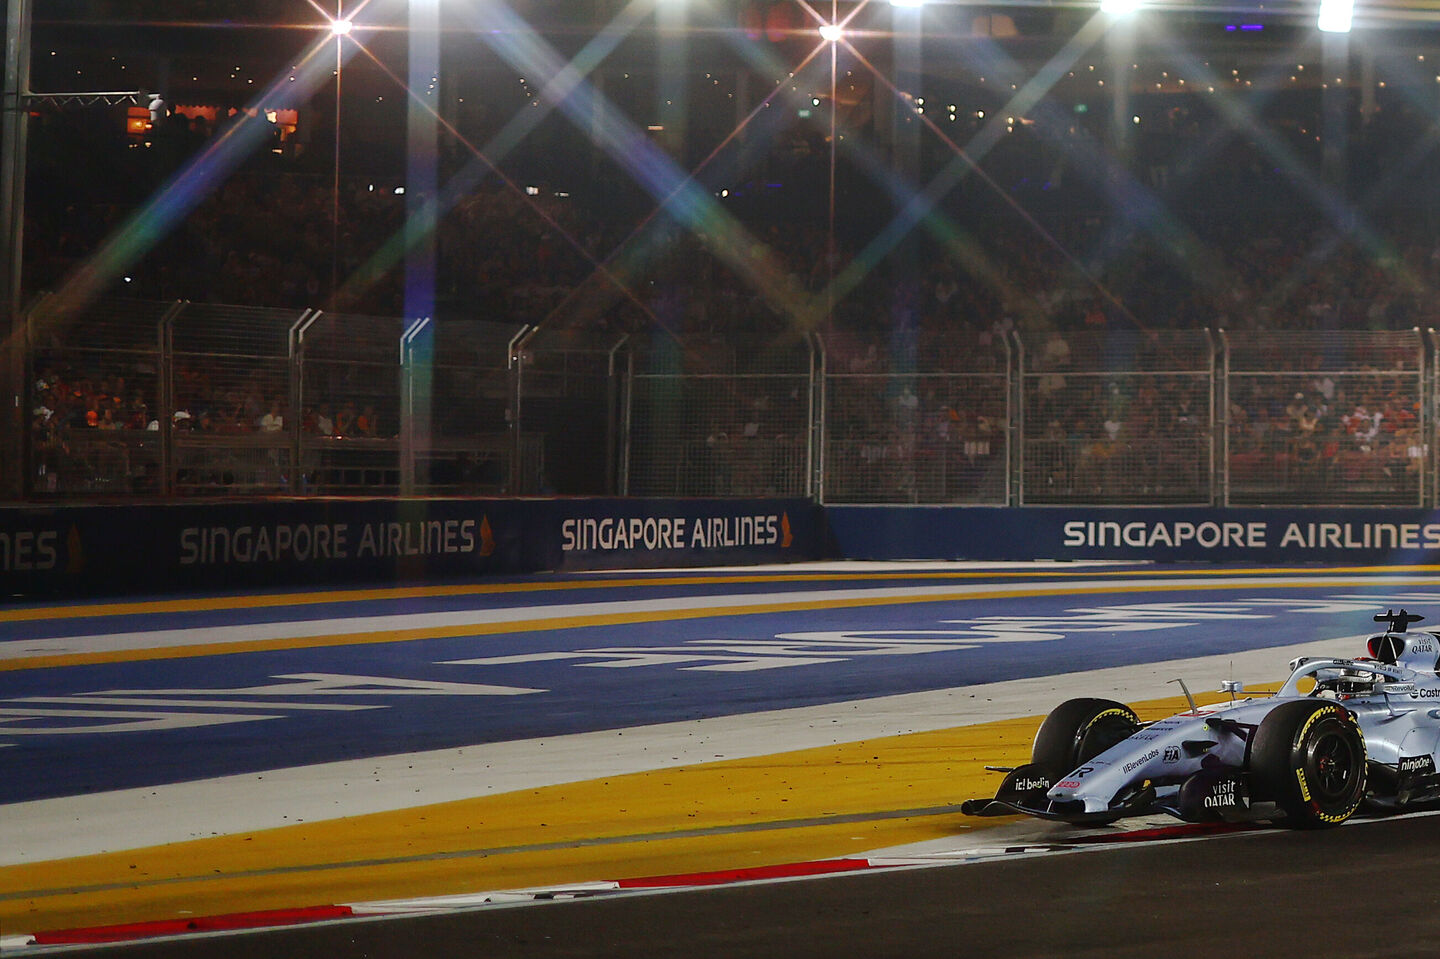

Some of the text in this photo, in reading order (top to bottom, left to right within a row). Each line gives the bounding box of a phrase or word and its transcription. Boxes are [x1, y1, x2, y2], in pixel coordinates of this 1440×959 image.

[180, 519, 475, 565] SINGAPORE AIRLINES
[562, 515, 778, 551] SINGAPORE AIRLINES
[1063, 521, 1267, 548] SINGAPORE
[1163, 747, 1181, 763] FIA
